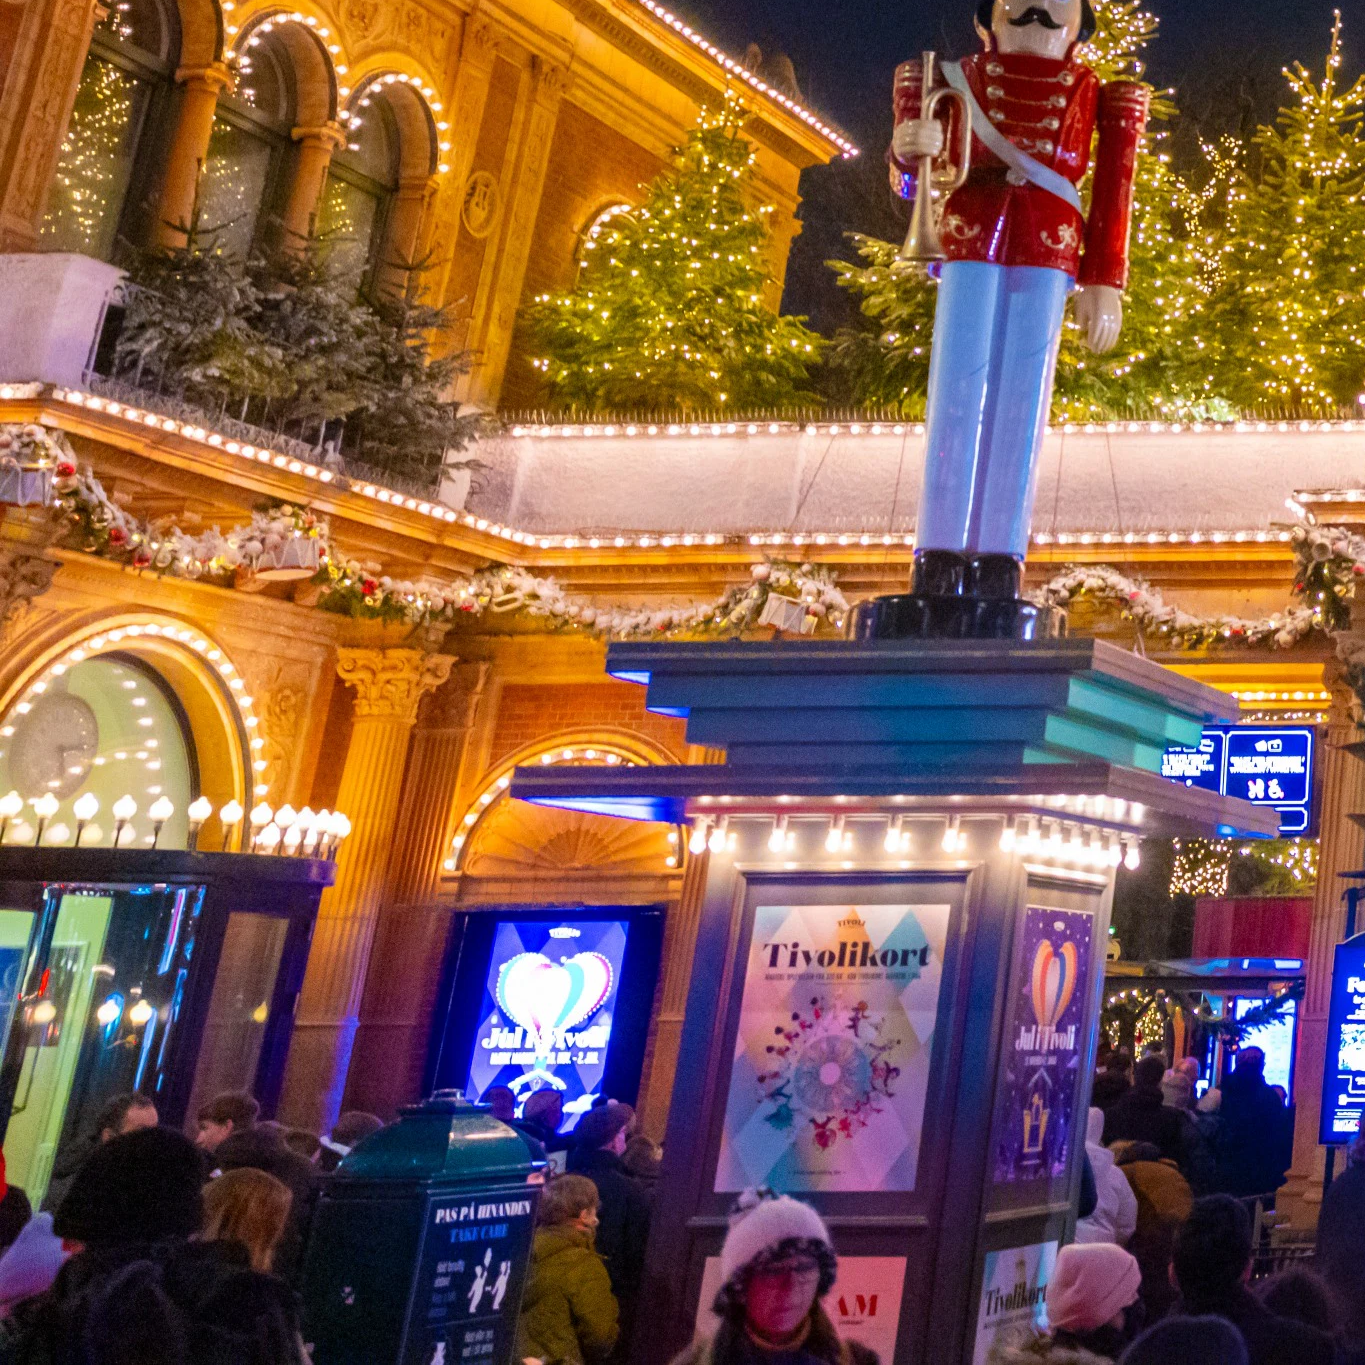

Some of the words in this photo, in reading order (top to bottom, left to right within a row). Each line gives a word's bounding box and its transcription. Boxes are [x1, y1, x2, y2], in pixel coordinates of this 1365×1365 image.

[838, 918, 866, 928] TIVOLI
[763, 941, 930, 968] Tivolikort
[482, 1026, 523, 1049] Jul
[1015, 1024, 1036, 1051] Jul
[435, 1207, 459, 1224] PAS
[459, 1201, 475, 1221] PÅ
[477, 1200, 532, 1220] HINANDEN
[450, 1226, 480, 1243] TAKE
[481, 1223, 510, 1241] CARE
[985, 1282, 1048, 1316] Tivolikort
